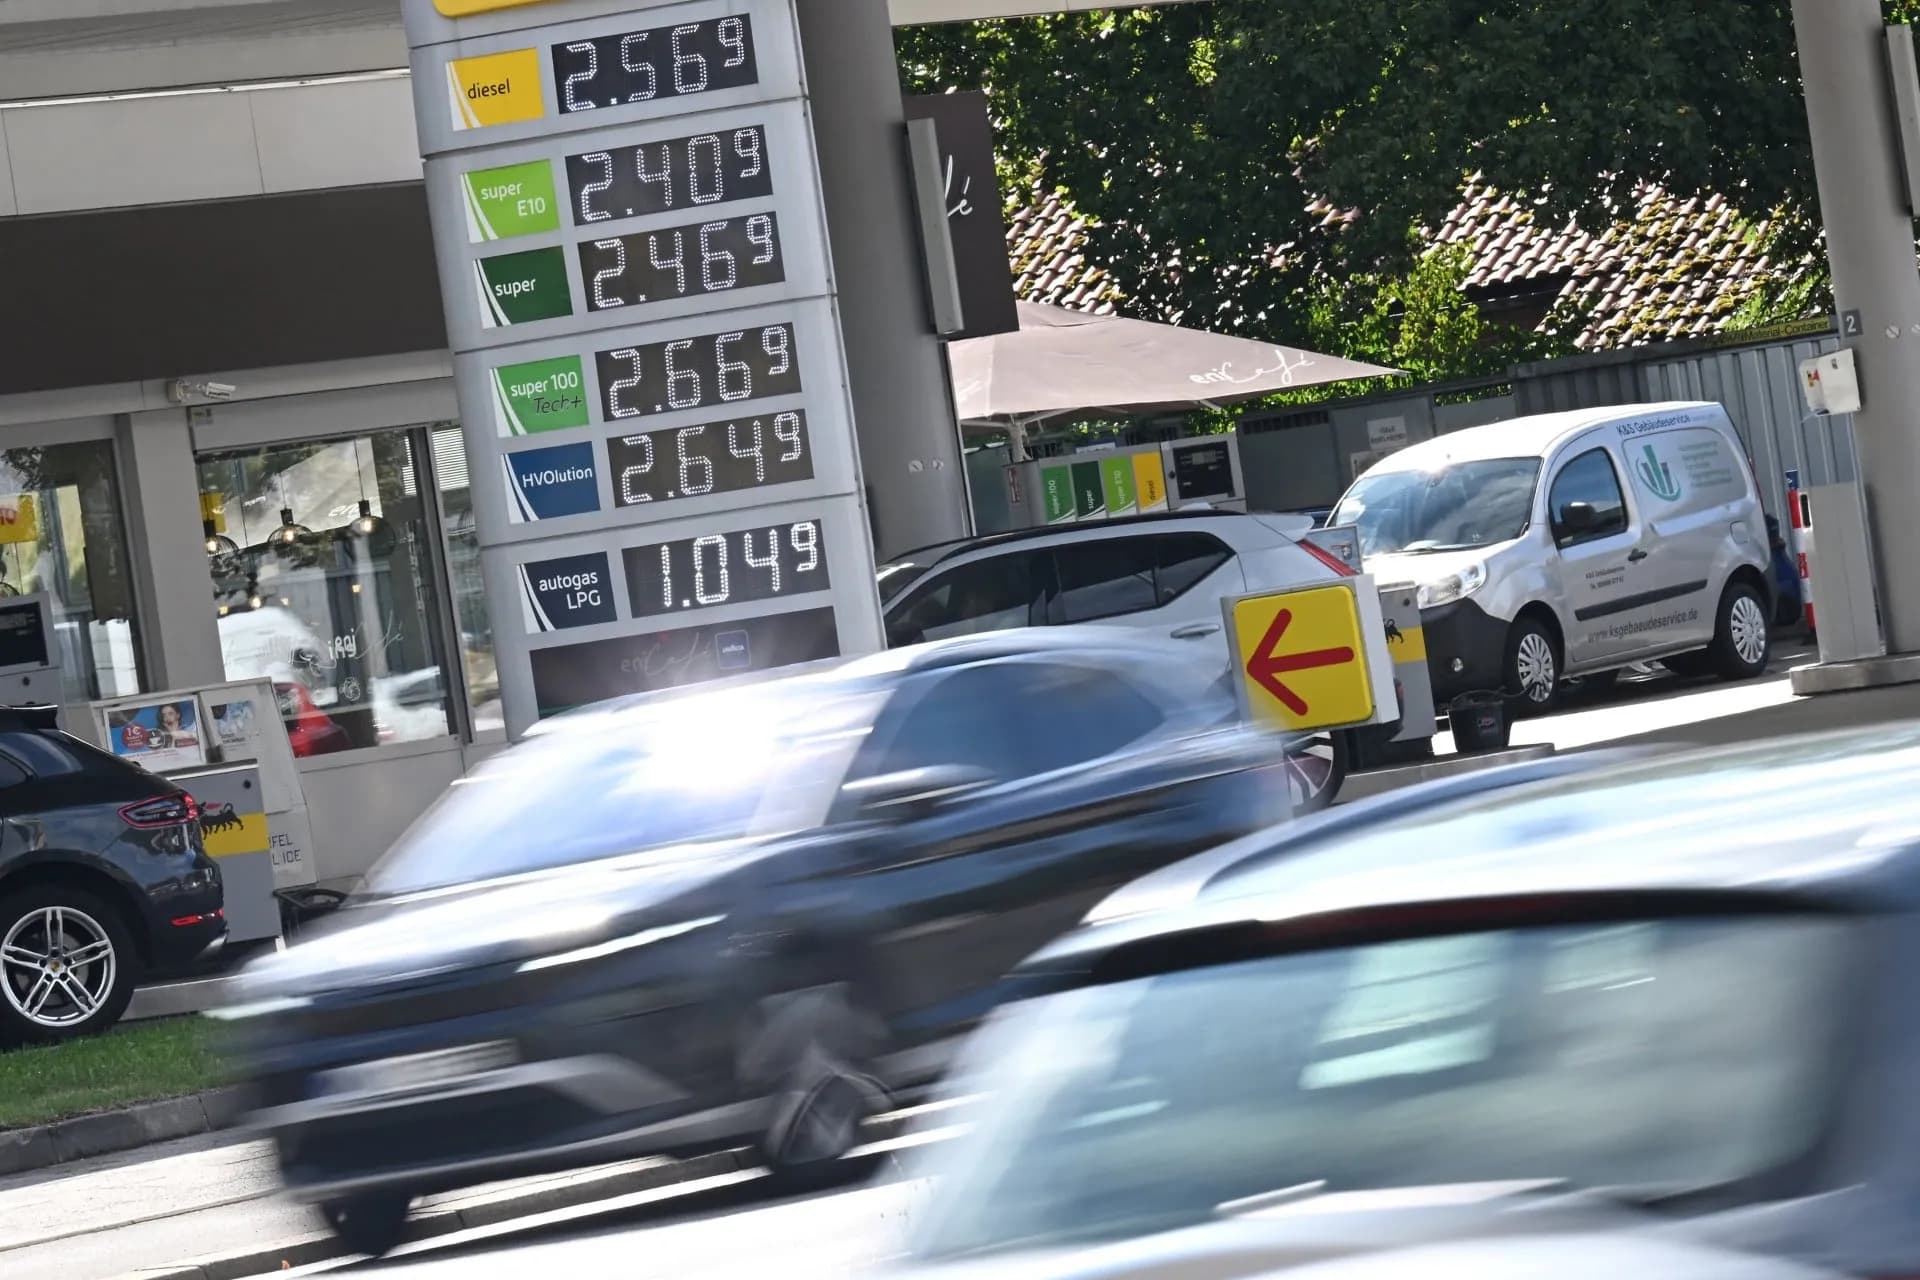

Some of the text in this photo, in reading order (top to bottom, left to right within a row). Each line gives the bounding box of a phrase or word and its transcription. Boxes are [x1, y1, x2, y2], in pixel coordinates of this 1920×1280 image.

[563, 17, 745, 112] 2.569
[467, 79, 511, 99] diesel
[580, 127, 761, 222] 2.409
[480, 182, 523, 202] super
[517, 197, 546, 217] E10
[593, 215, 773, 309] 2.469
[495, 277, 537, 299] super
[1846, 315, 1857, 333] 2
[609, 326, 790, 418] 2.669
[510, 371, 578, 399] super 100
[533, 394, 583, 415] Tech+
[621, 411, 803, 504] 2.649
[522, 466, 593, 488] HVOlution
[1048, 480, 1056, 494] 100
[1085, 490, 1096, 510] super
[1147, 480, 1156, 501] diesel
[660, 521, 819, 607] 1.049
[539, 570, 599, 594] autogas
[566, 591, 602, 611] LPG
